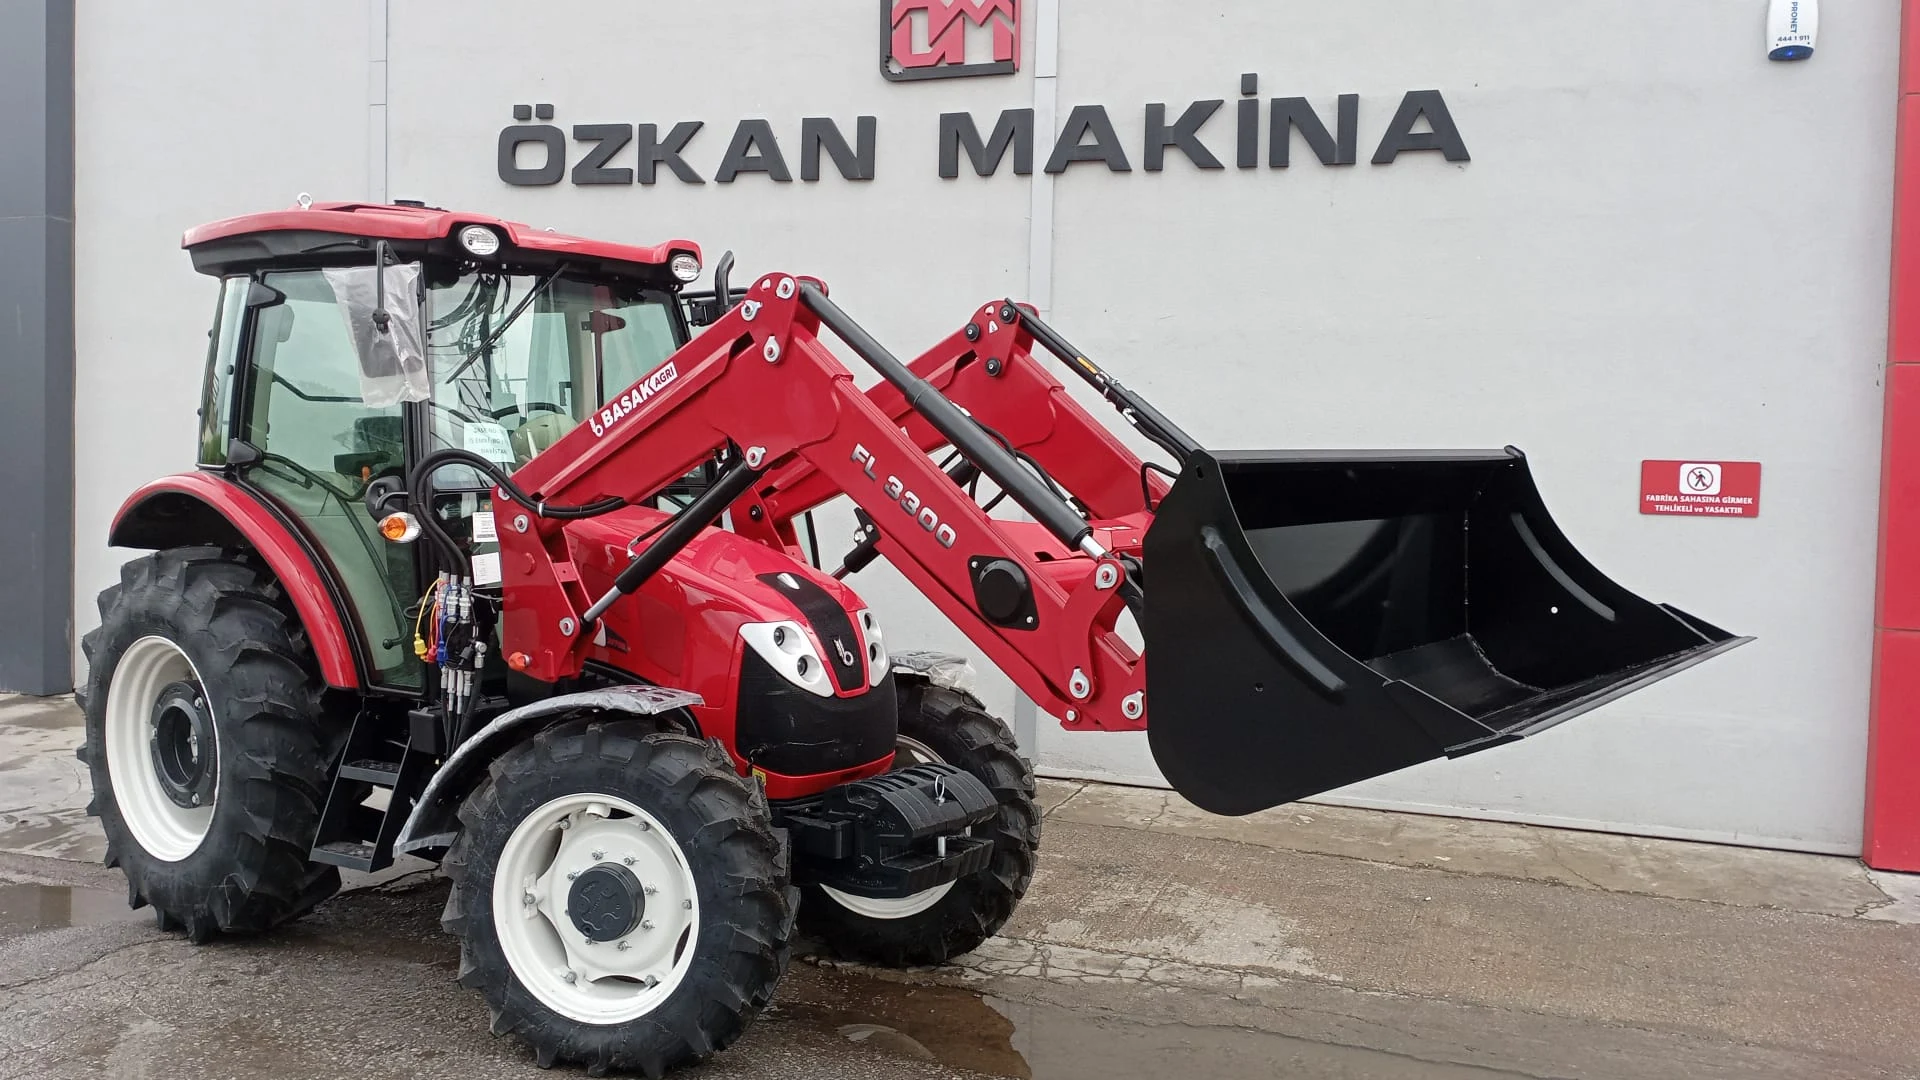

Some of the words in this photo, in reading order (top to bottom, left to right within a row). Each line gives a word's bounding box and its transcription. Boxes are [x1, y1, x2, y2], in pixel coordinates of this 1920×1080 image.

[1790, 1, 1798, 33] PRONET
[497, 103, 877, 186] ÖZKAN
[938, 73, 1472, 178] MAKİNA
[654, 365, 675, 388] AGRI
[850, 442, 877, 481] FL
[883, 474, 957, 549] 3300
[1645, 494, 1679, 502] FABRİKA
[1680, 495, 1721, 503] SAHASINA
[1722, 496, 1753, 504] GİRMEK
[1654, 503, 1693, 513] TEHLİKELİ
[1705, 506, 1743, 514] YASAKTIR
